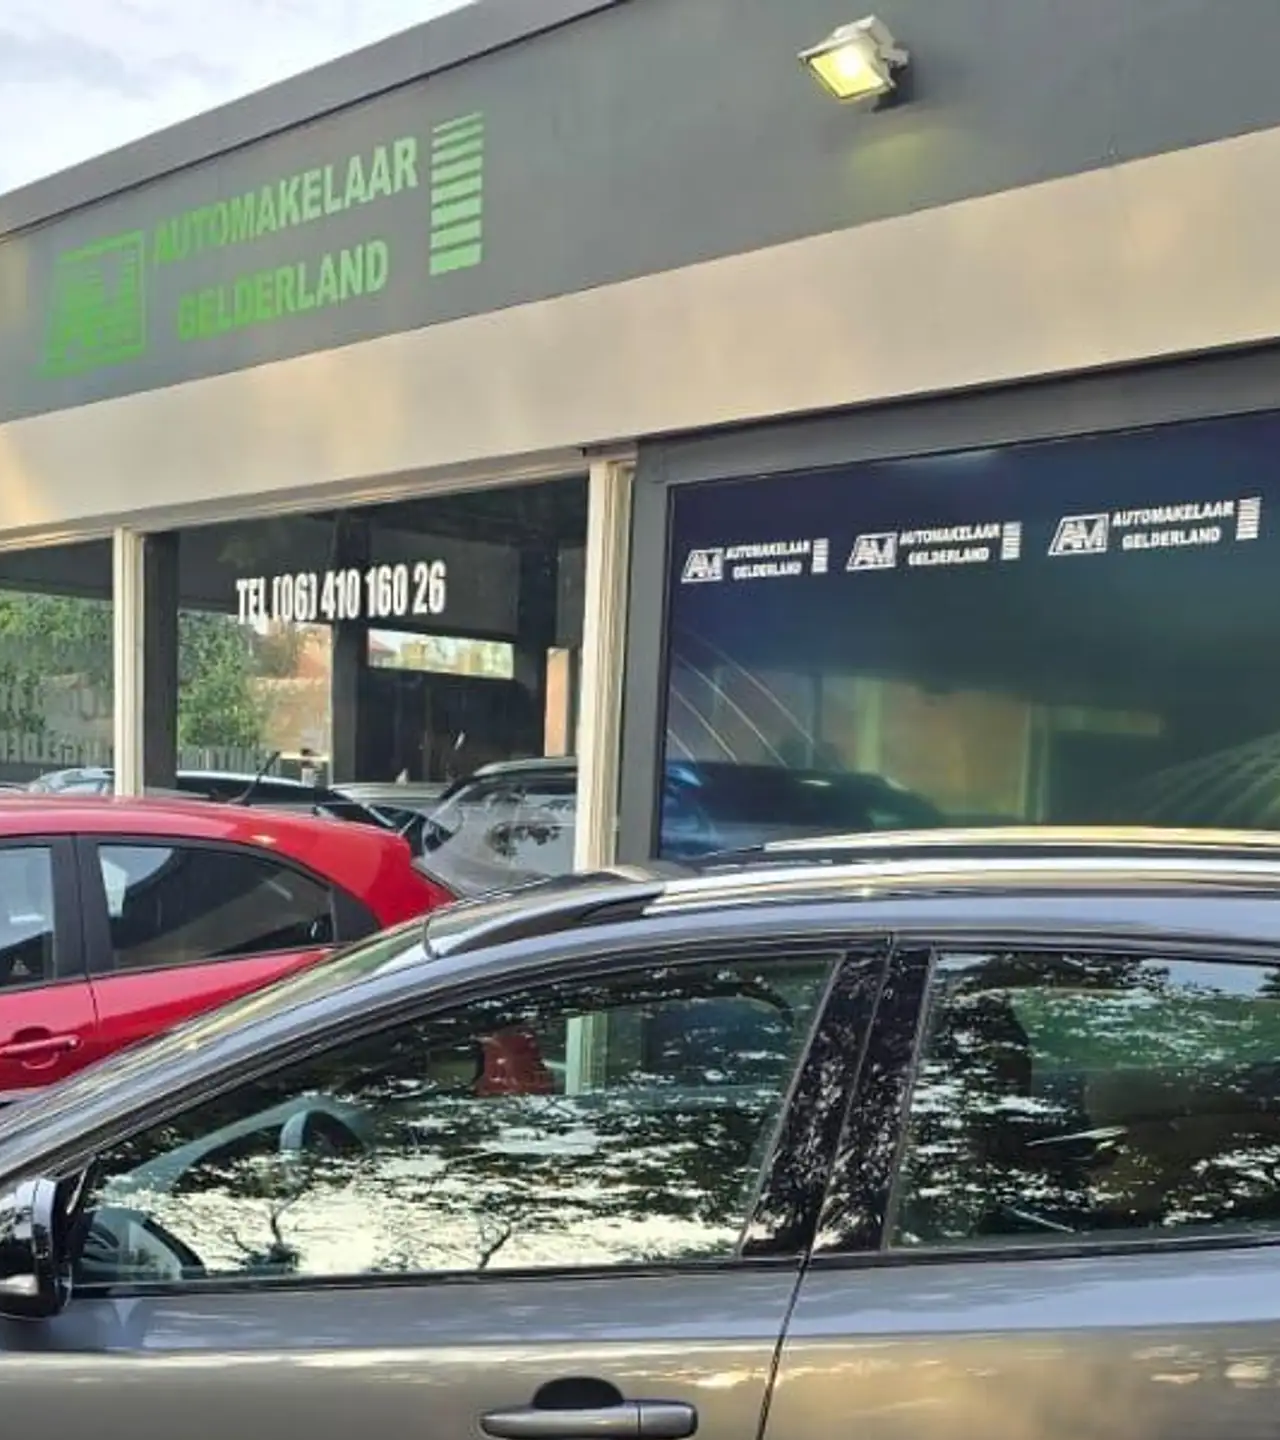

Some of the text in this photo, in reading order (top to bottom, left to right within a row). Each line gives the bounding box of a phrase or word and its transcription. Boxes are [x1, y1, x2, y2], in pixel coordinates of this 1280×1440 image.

[151, 136, 419, 267] AUTOMAKELAAR
[177, 240, 390, 343] GELDERLAND
[1112, 501, 1235, 528] AUTOMAKELAAR
[1122, 526, 1221, 551] GELDERLAND
[321, 568, 361, 621] 410
[365, 563, 409, 618] 160
[413, 559, 447, 614] 26
